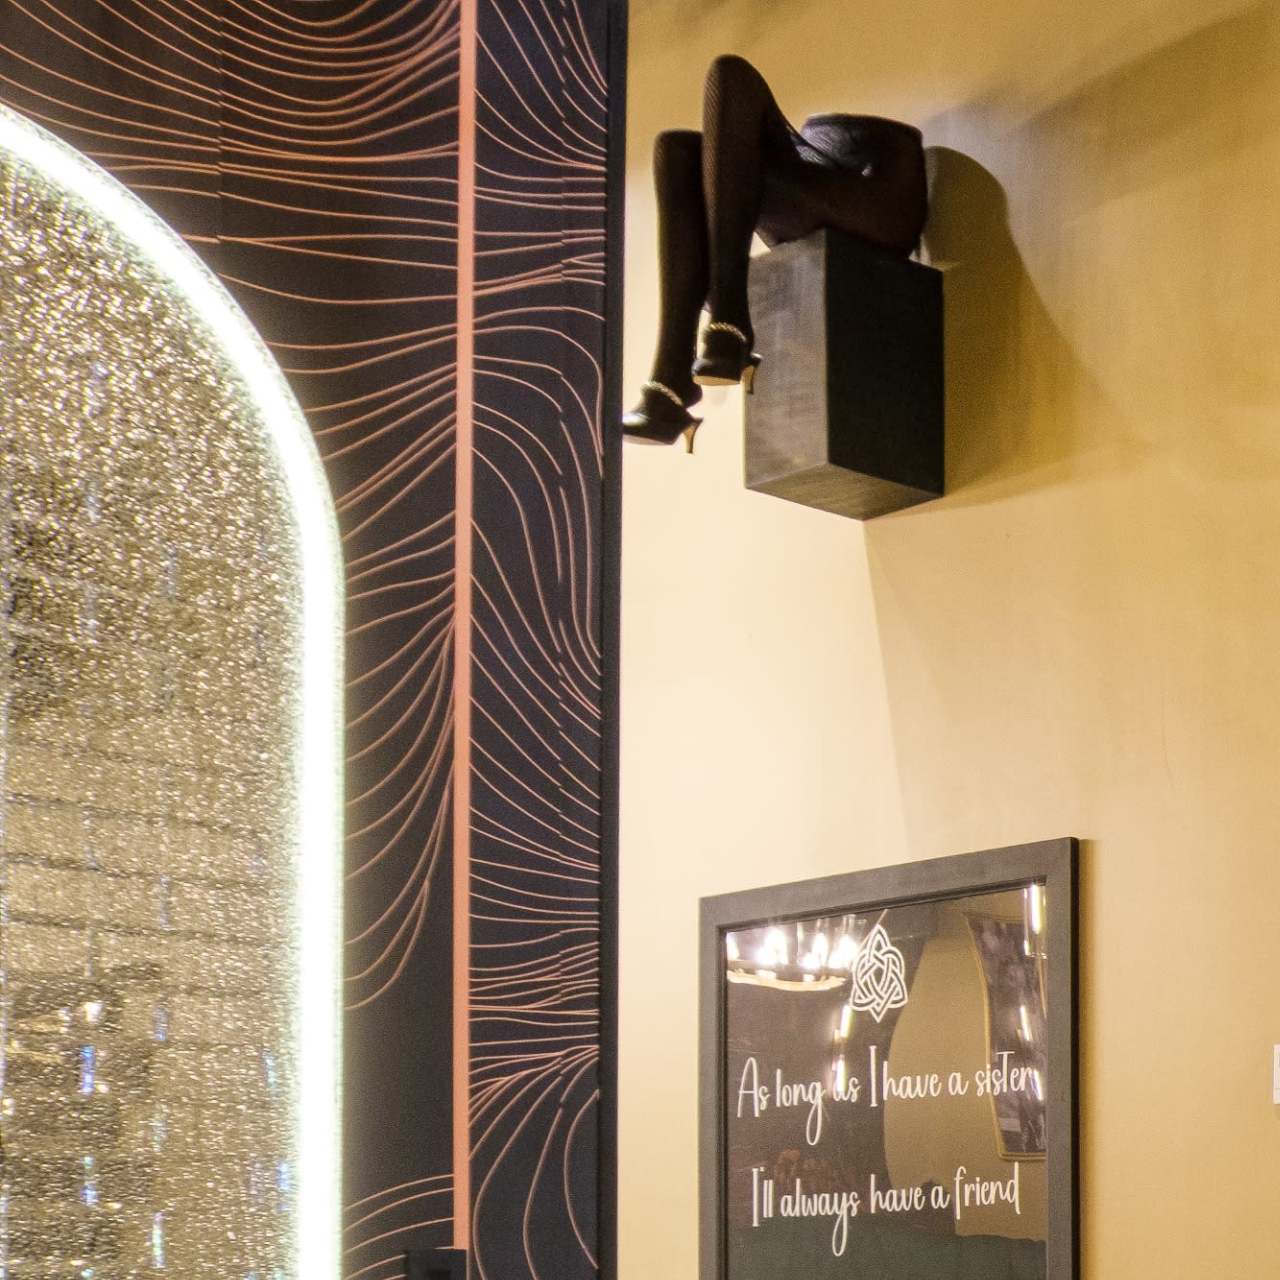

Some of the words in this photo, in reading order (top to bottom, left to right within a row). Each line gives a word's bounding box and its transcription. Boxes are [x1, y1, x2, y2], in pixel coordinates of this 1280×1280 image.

[737, 1057, 770, 1118] As
[776, 1069, 826, 1146] long
[832, 1075, 861, 1103] as
[869, 1045, 879, 1107] I
[883, 1060, 942, 1101] have
[949, 1071, 968, 1097] a
[975, 1051, 1034, 1097] sister
[752, 1166, 774, 1227] I'll
[780, 1178, 861, 1257] always
[870, 1174, 925, 1214] have
[931, 1185, 950, 1209] a
[954, 1161, 1021, 1220] friend
